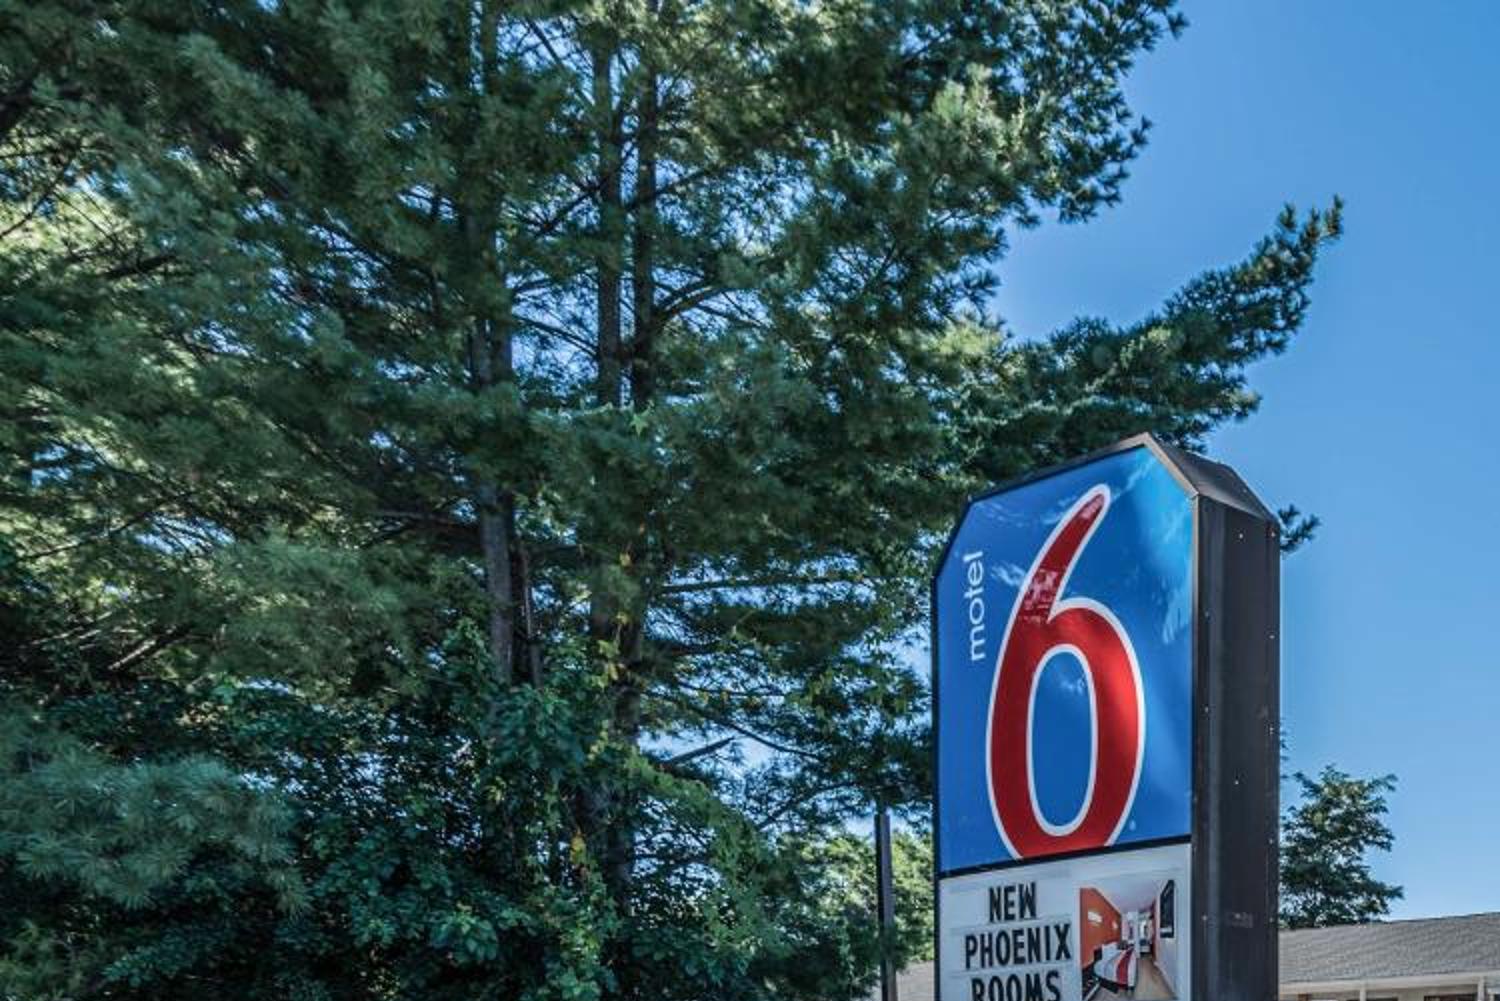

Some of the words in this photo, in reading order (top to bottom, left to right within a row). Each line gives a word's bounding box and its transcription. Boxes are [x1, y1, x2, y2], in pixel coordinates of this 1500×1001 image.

[963, 551, 985, 661] motel
[986, 483, 1146, 860] 6
[989, 882, 1037, 922] NEW
[965, 923, 1071, 970] PHOENIX
